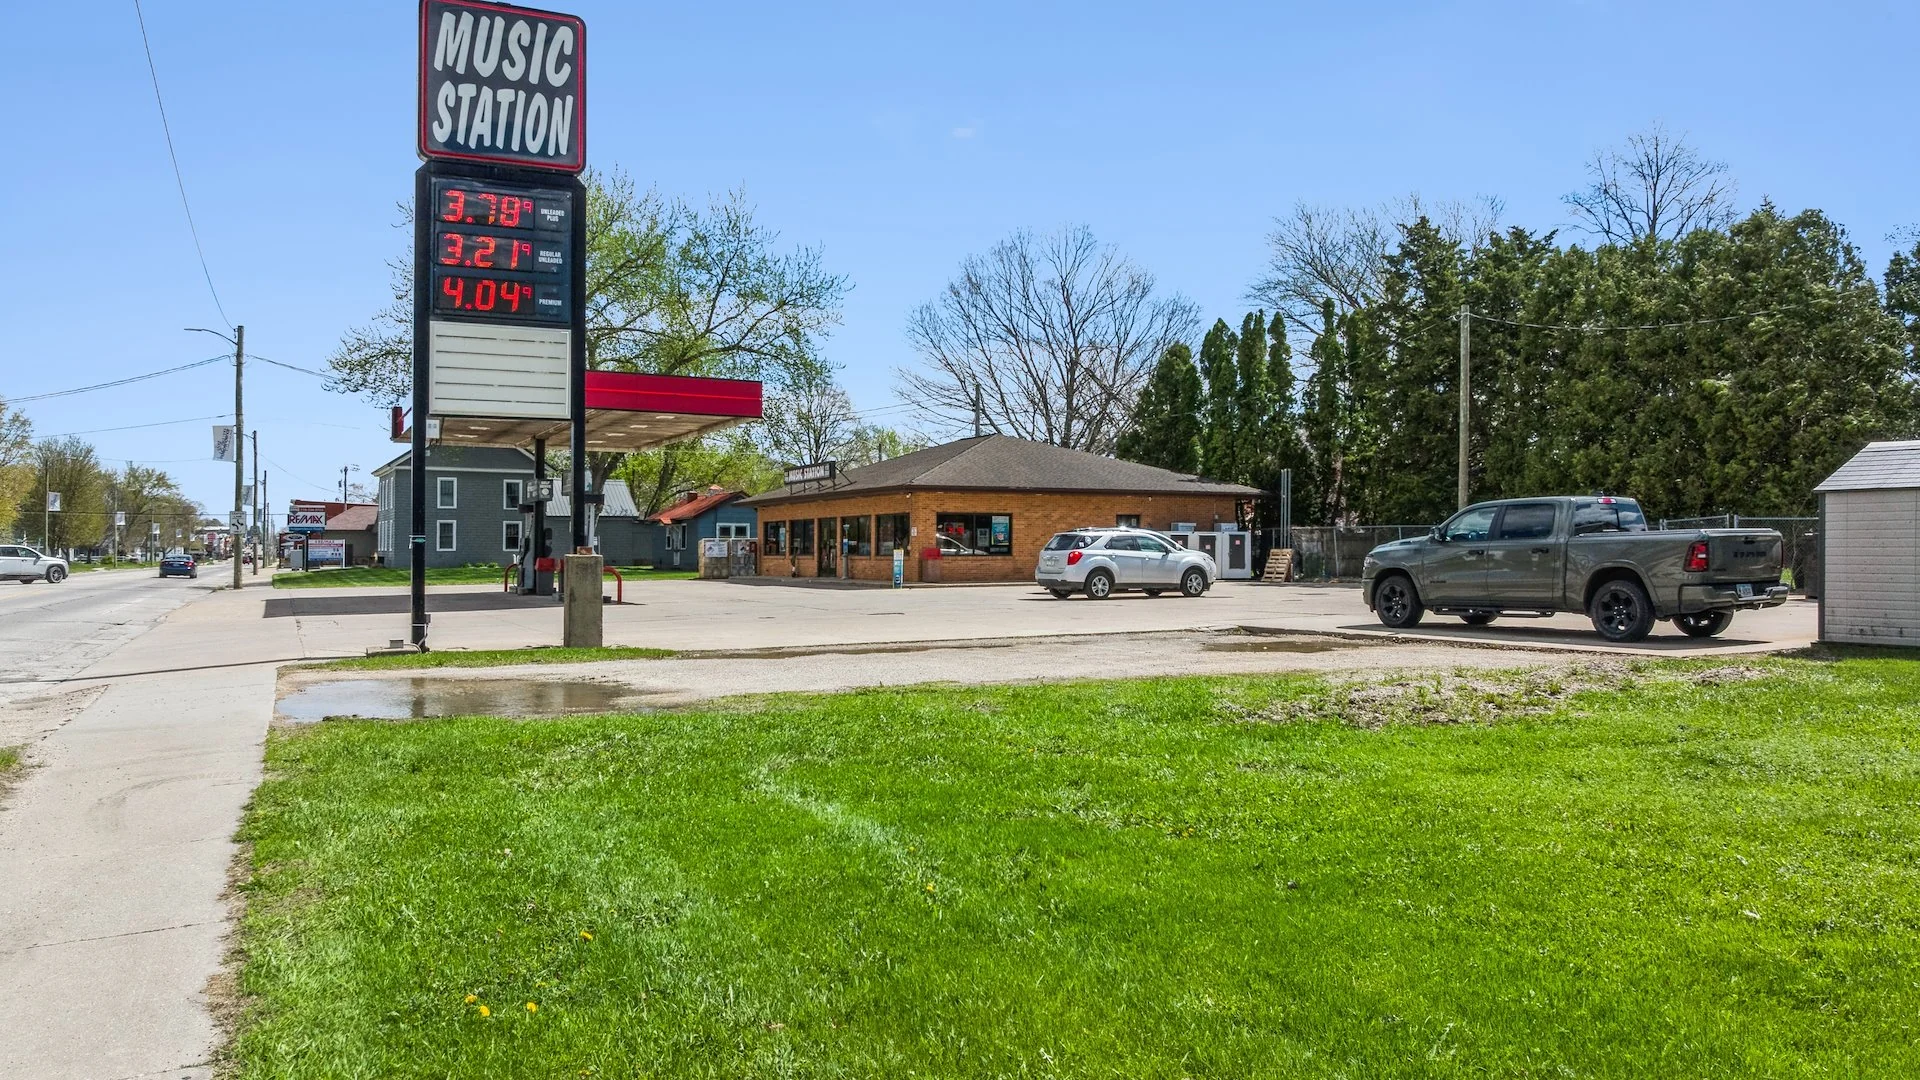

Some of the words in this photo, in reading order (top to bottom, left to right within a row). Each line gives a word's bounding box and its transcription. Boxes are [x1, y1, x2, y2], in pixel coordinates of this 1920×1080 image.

[434, 11, 574, 87] MUSIC
[432, 80, 574, 156] STATION
[541, 208, 565, 216] UNLEADED
[540, 250, 562, 258] REGULAR
[538, 256, 563, 264] UNLEADED
[289, 514, 323, 524] RE/MAX
